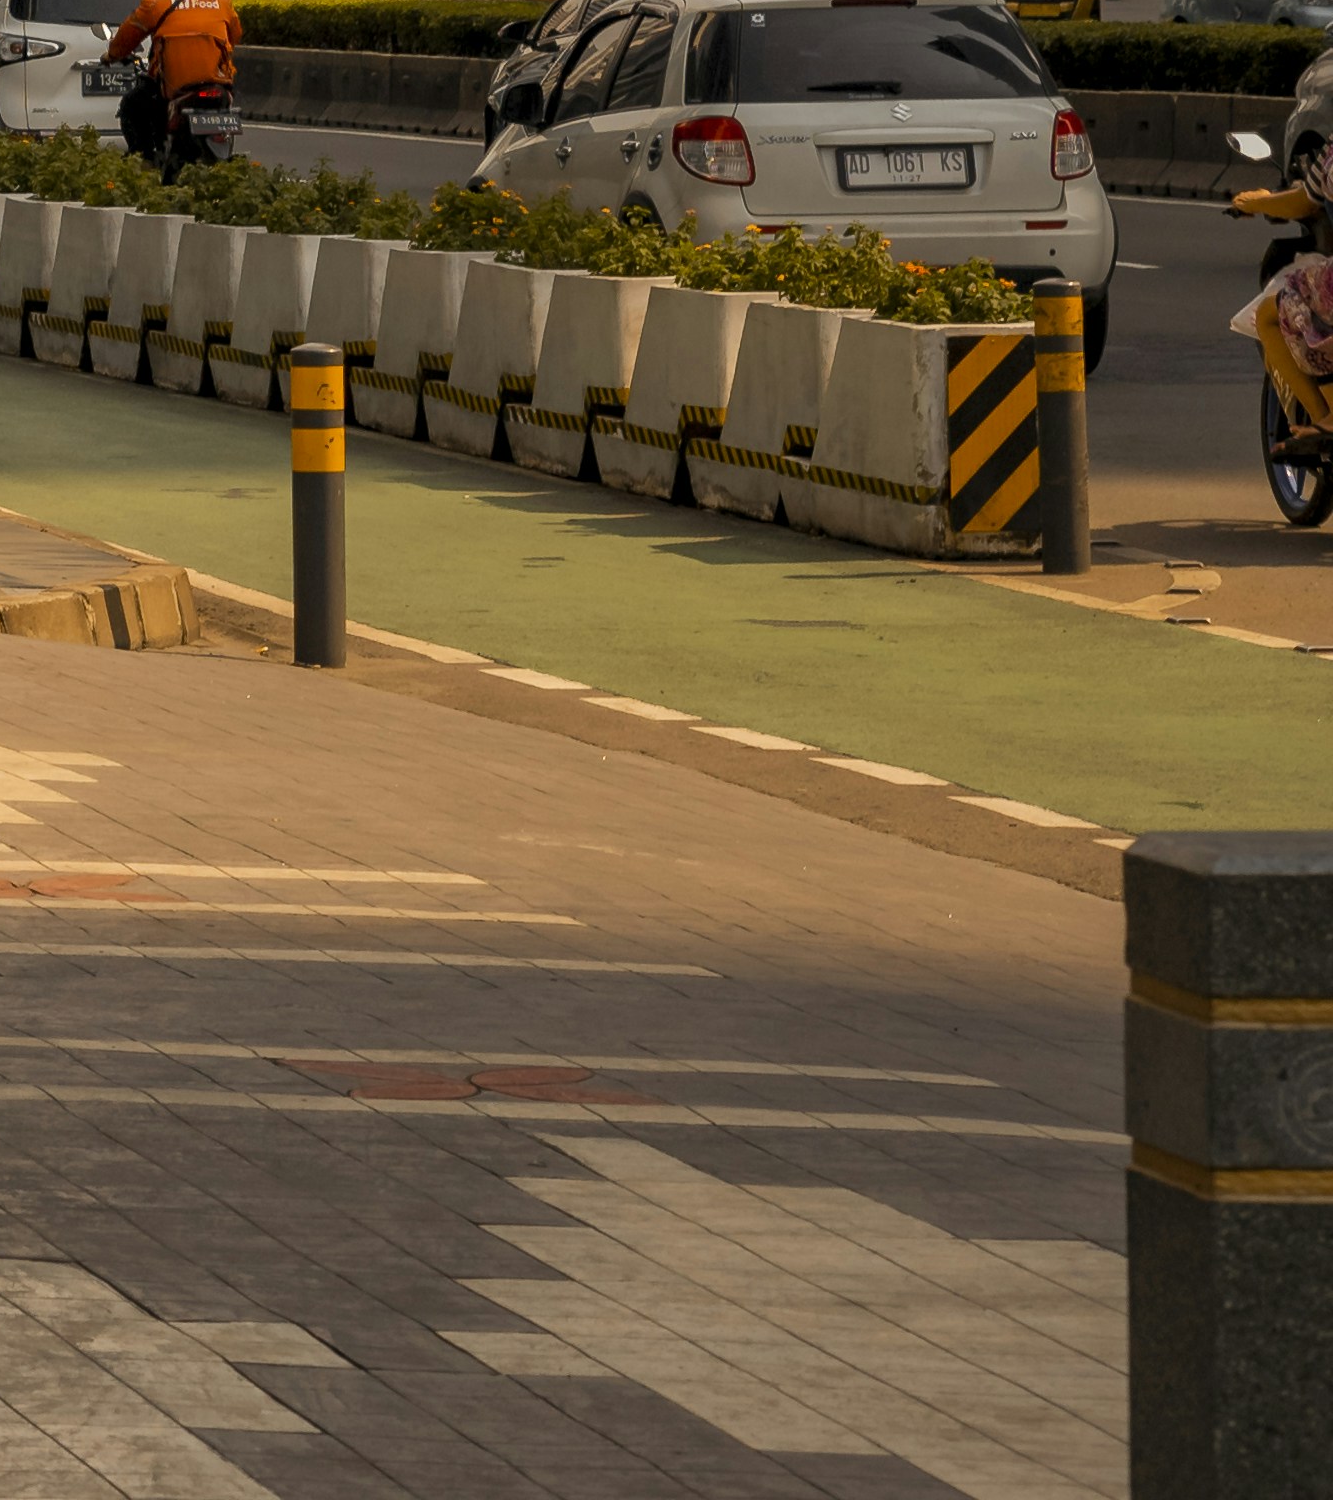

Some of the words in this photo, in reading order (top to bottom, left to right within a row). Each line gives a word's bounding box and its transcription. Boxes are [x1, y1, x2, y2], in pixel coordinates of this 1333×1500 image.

[191, 0, 220, 10] Food
[85, 73, 92, 87] B
[848, 154, 870, 175] AD
[884, 152, 926, 174] 1061
[940, 150, 963, 172] KS
